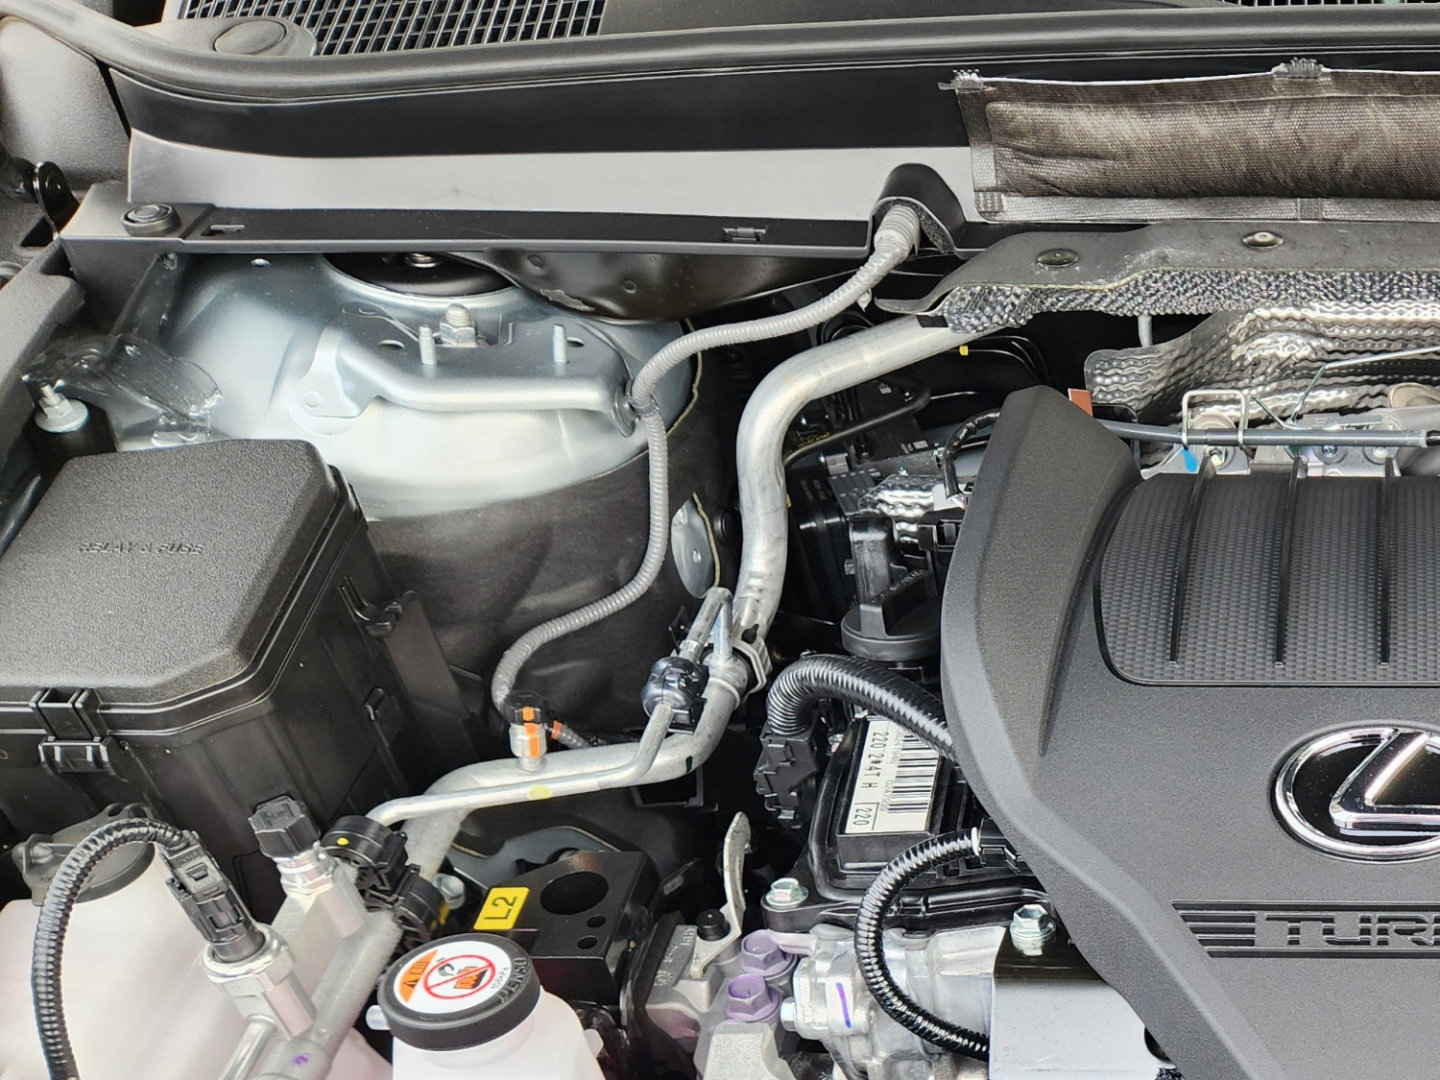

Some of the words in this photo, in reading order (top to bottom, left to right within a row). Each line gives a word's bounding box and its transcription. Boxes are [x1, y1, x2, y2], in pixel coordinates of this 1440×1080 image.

[869, 732, 889, 749] 220
[852, 807, 873, 826] 220
[483, 896, 518, 921] L2
[498, 957, 529, 1003] DENSO
